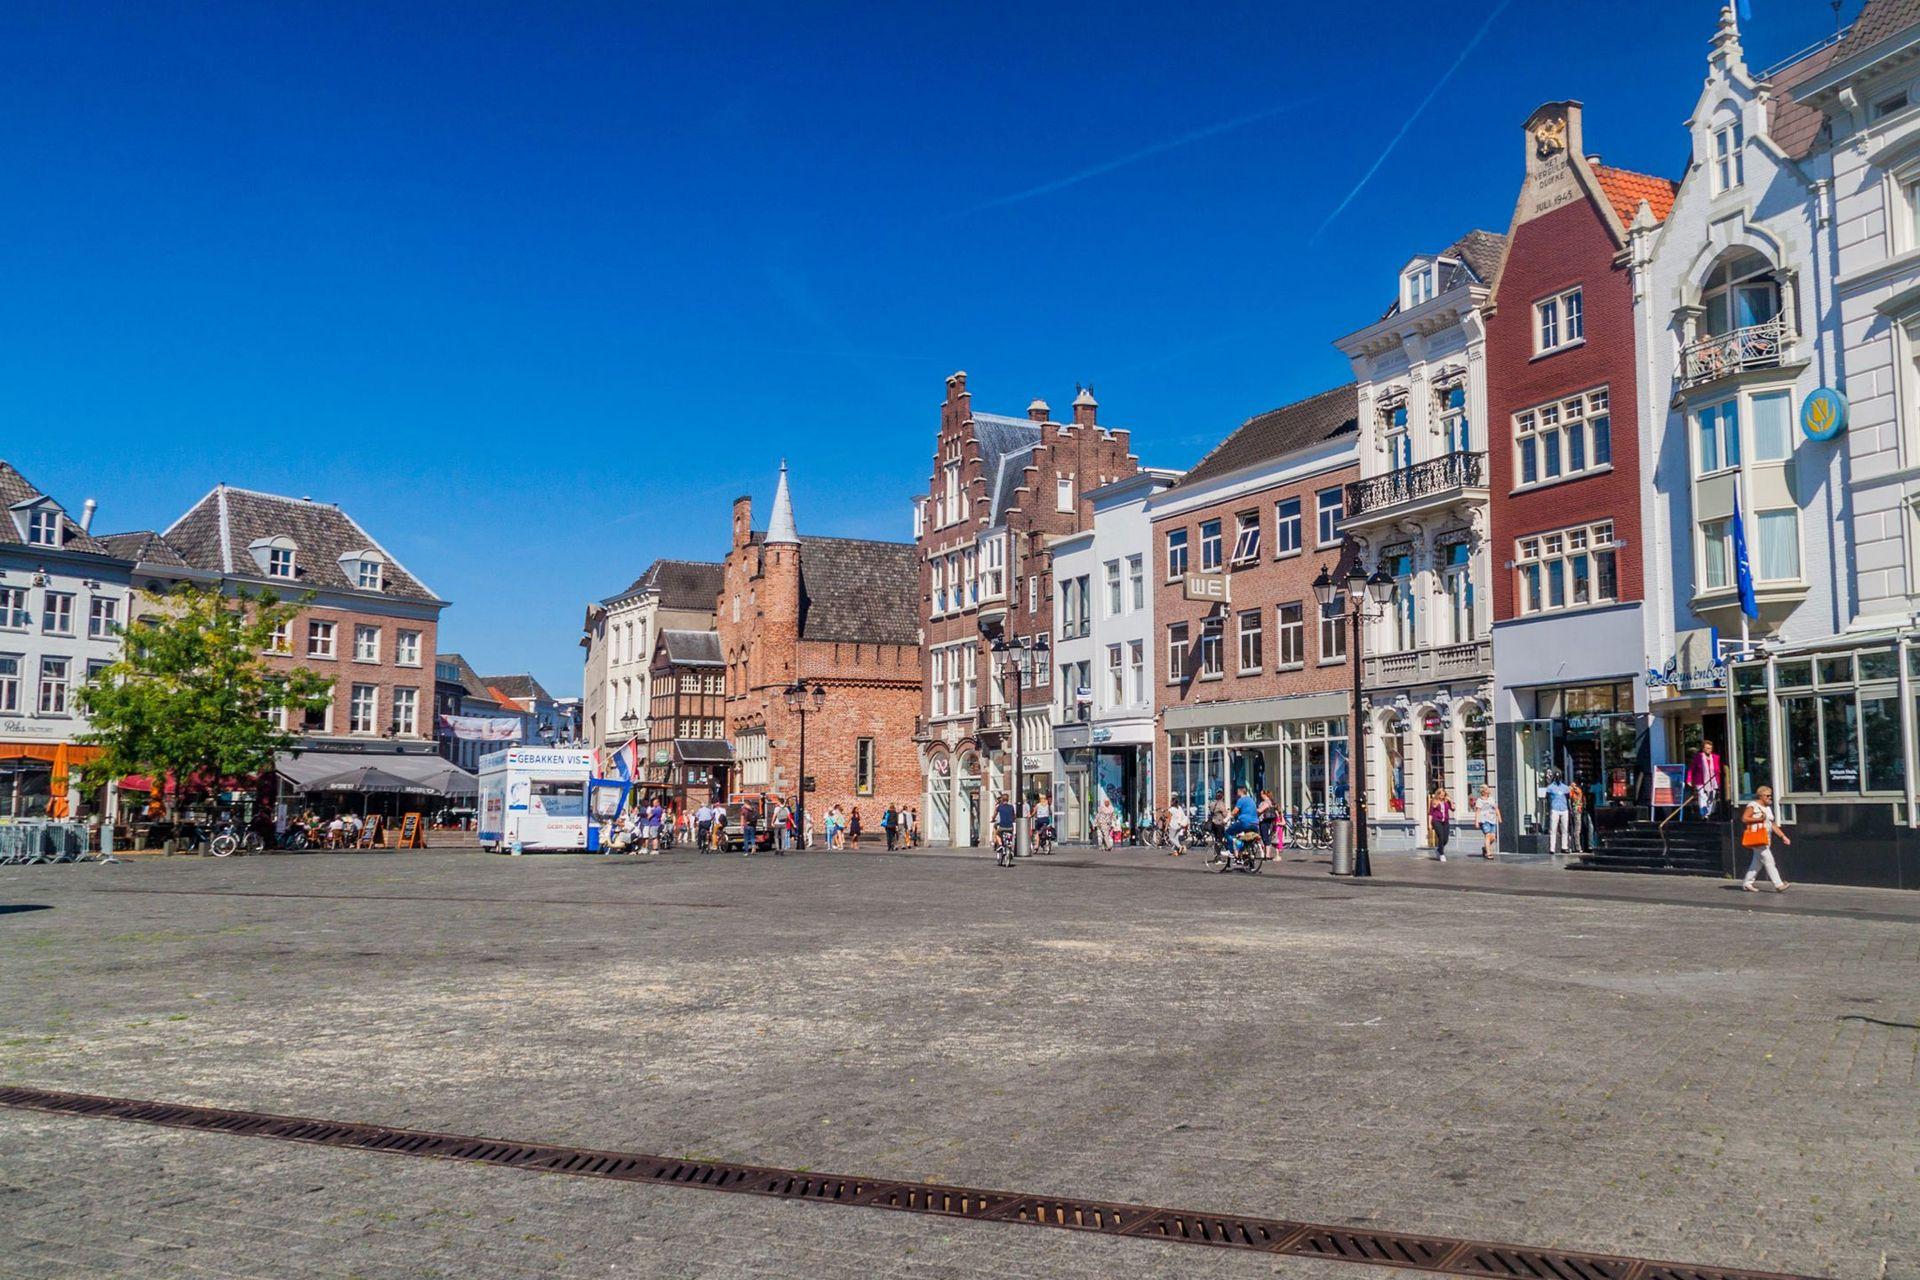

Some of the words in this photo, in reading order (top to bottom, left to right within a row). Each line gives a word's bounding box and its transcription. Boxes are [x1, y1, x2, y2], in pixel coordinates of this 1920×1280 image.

[1191, 578, 1222, 596] WE
[1308, 722, 1325, 735] WE
[1191, 731, 1205, 744] WE
[517, 754, 564, 764] GEBAKKEN
[567, 755, 581, 765] VIS
